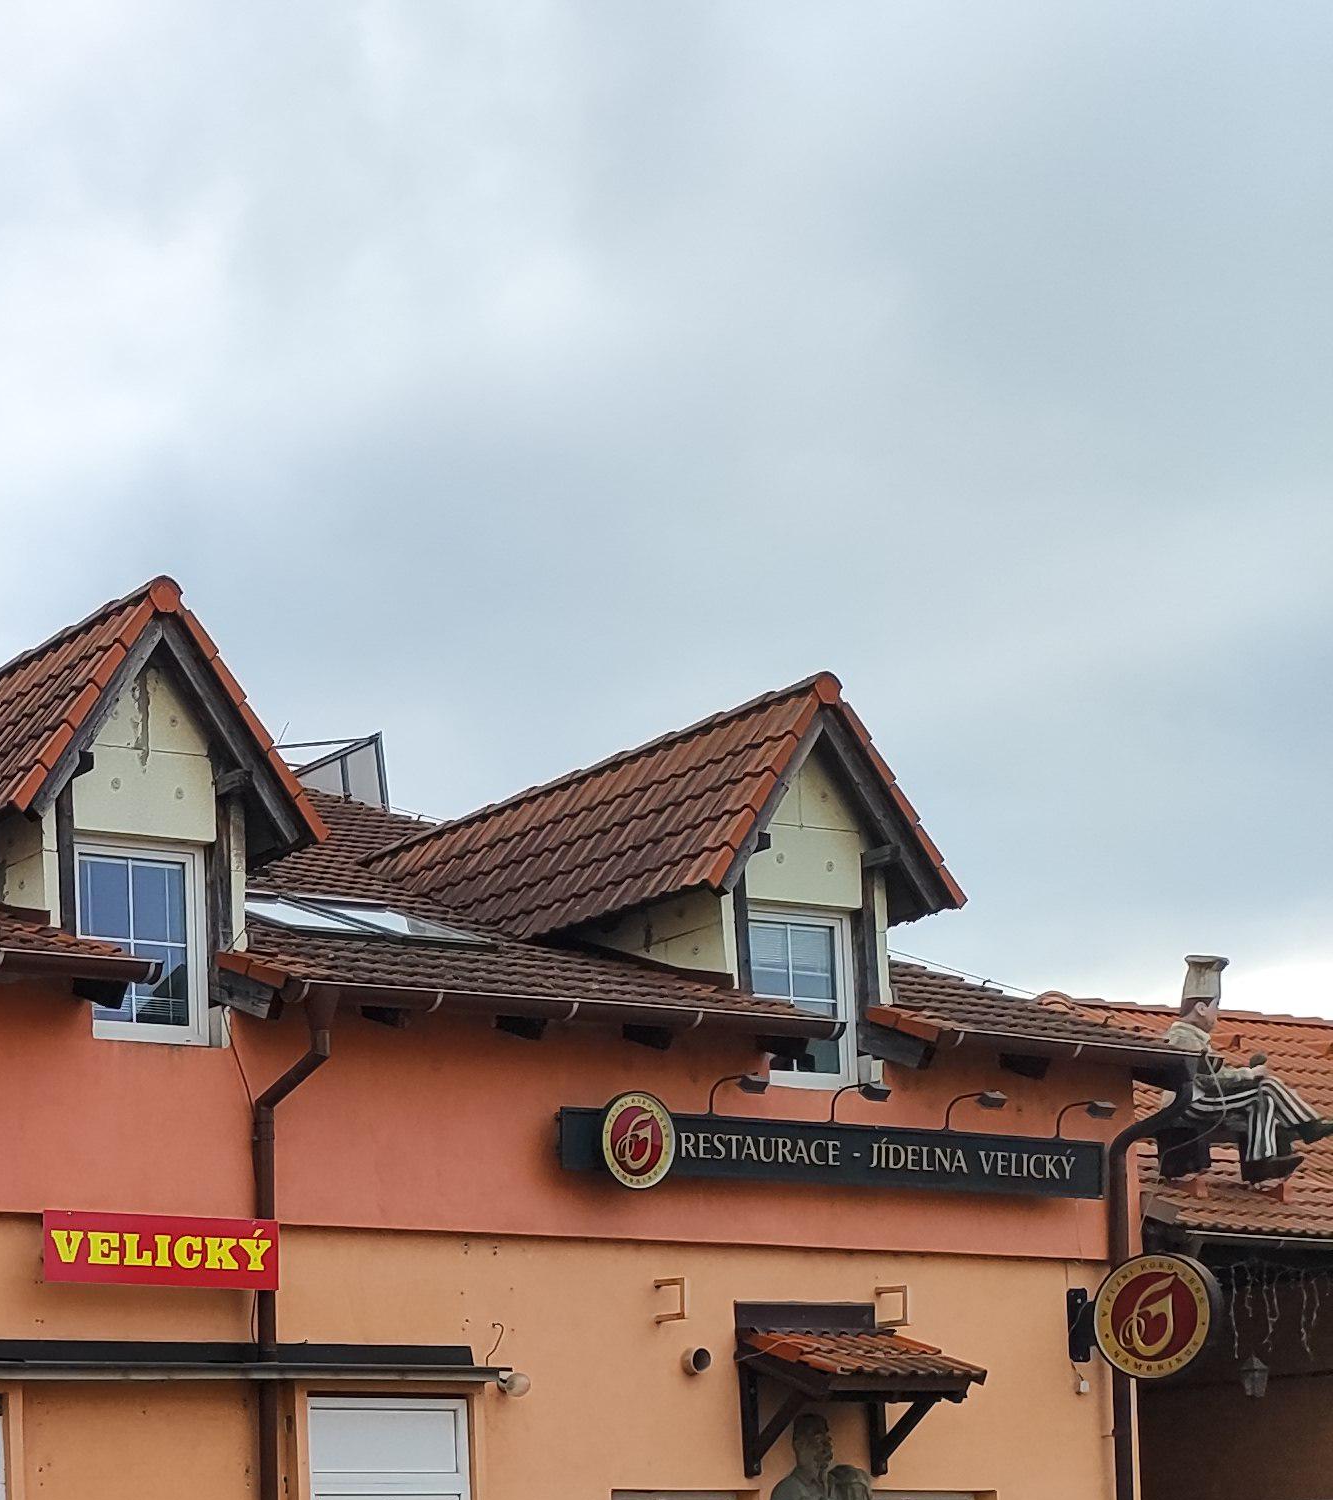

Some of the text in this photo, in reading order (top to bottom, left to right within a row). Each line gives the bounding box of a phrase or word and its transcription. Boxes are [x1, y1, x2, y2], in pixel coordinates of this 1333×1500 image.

[679, 1131, 841, 1166] RESTAURACE
[869, 1137, 969, 1174] JÍDELNA
[978, 1149, 1076, 1180] VELICKÝ
[50, 1228, 272, 1272] VELICKÝ
